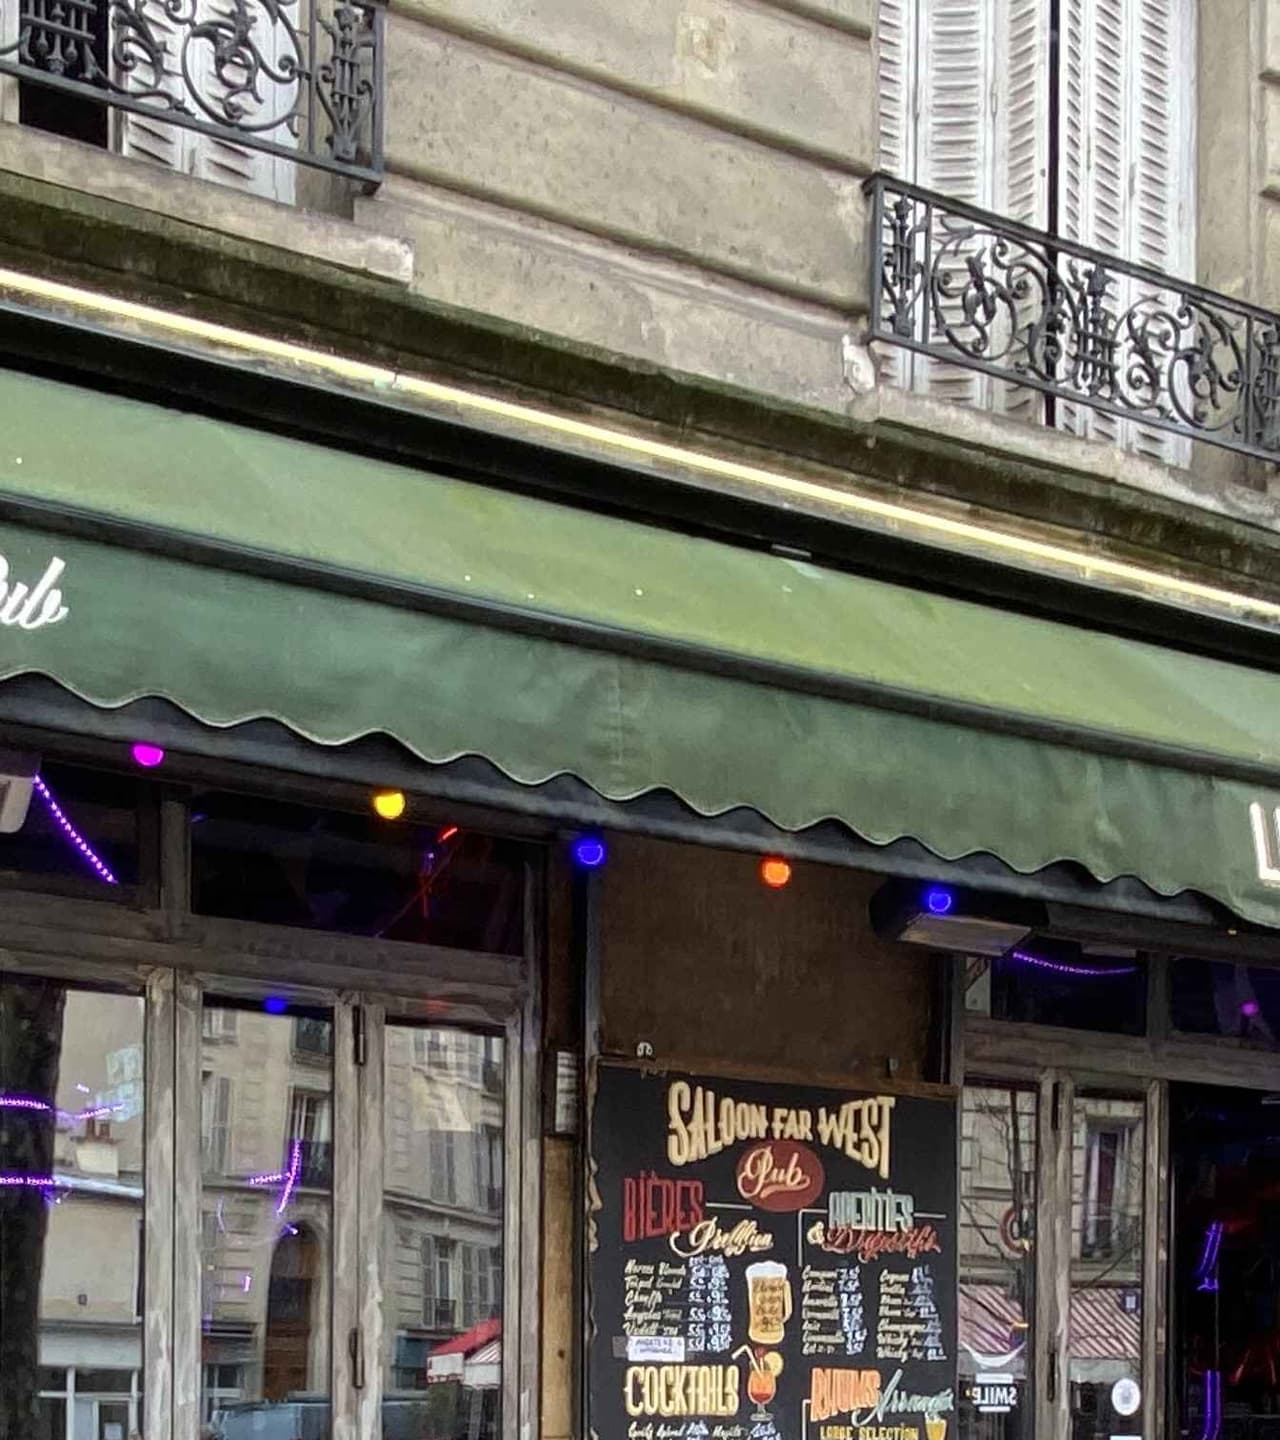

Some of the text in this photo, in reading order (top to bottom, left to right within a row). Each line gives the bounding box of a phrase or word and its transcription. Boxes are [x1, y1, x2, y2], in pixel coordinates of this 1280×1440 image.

[668, 1080, 896, 1179] SALOON FAR WEST
[737, 1145, 811, 1198] Pub
[624, 1365, 740, 1417] COCKTAILS
